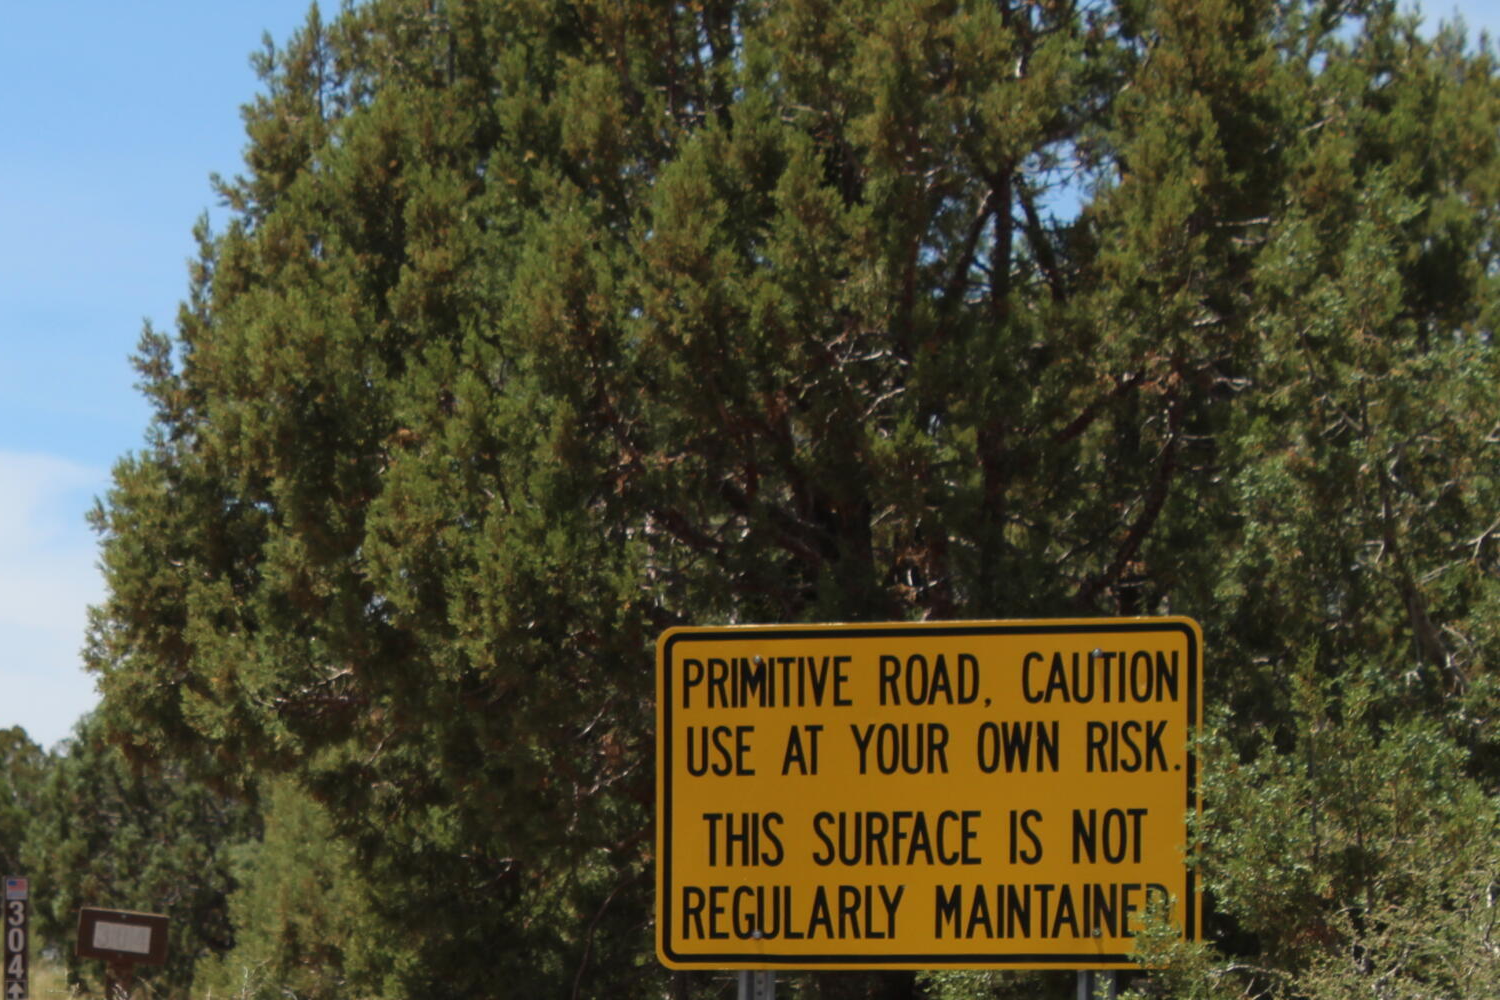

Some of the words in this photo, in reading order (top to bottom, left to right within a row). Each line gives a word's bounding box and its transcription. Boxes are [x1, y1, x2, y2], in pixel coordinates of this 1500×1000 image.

[682, 655, 852, 708] PRIMITIVE
[879, 653, 991, 707] ROAD,
[1022, 650, 1179, 705] CAUTION
[687, 725, 755, 777] USE
[781, 724, 823, 776] AT
[851, 722, 949, 775] YOUR
[977, 720, 1059, 774] OWN
[1086, 720, 1181, 773] RISK.
[703, 812, 784, 866] THIS
[813, 810, 981, 866] SURFACE
[1009, 809, 1042, 865] IS
[1072, 808, 1147, 864] NOT
[682, 885, 905, 939] REGULARLY
